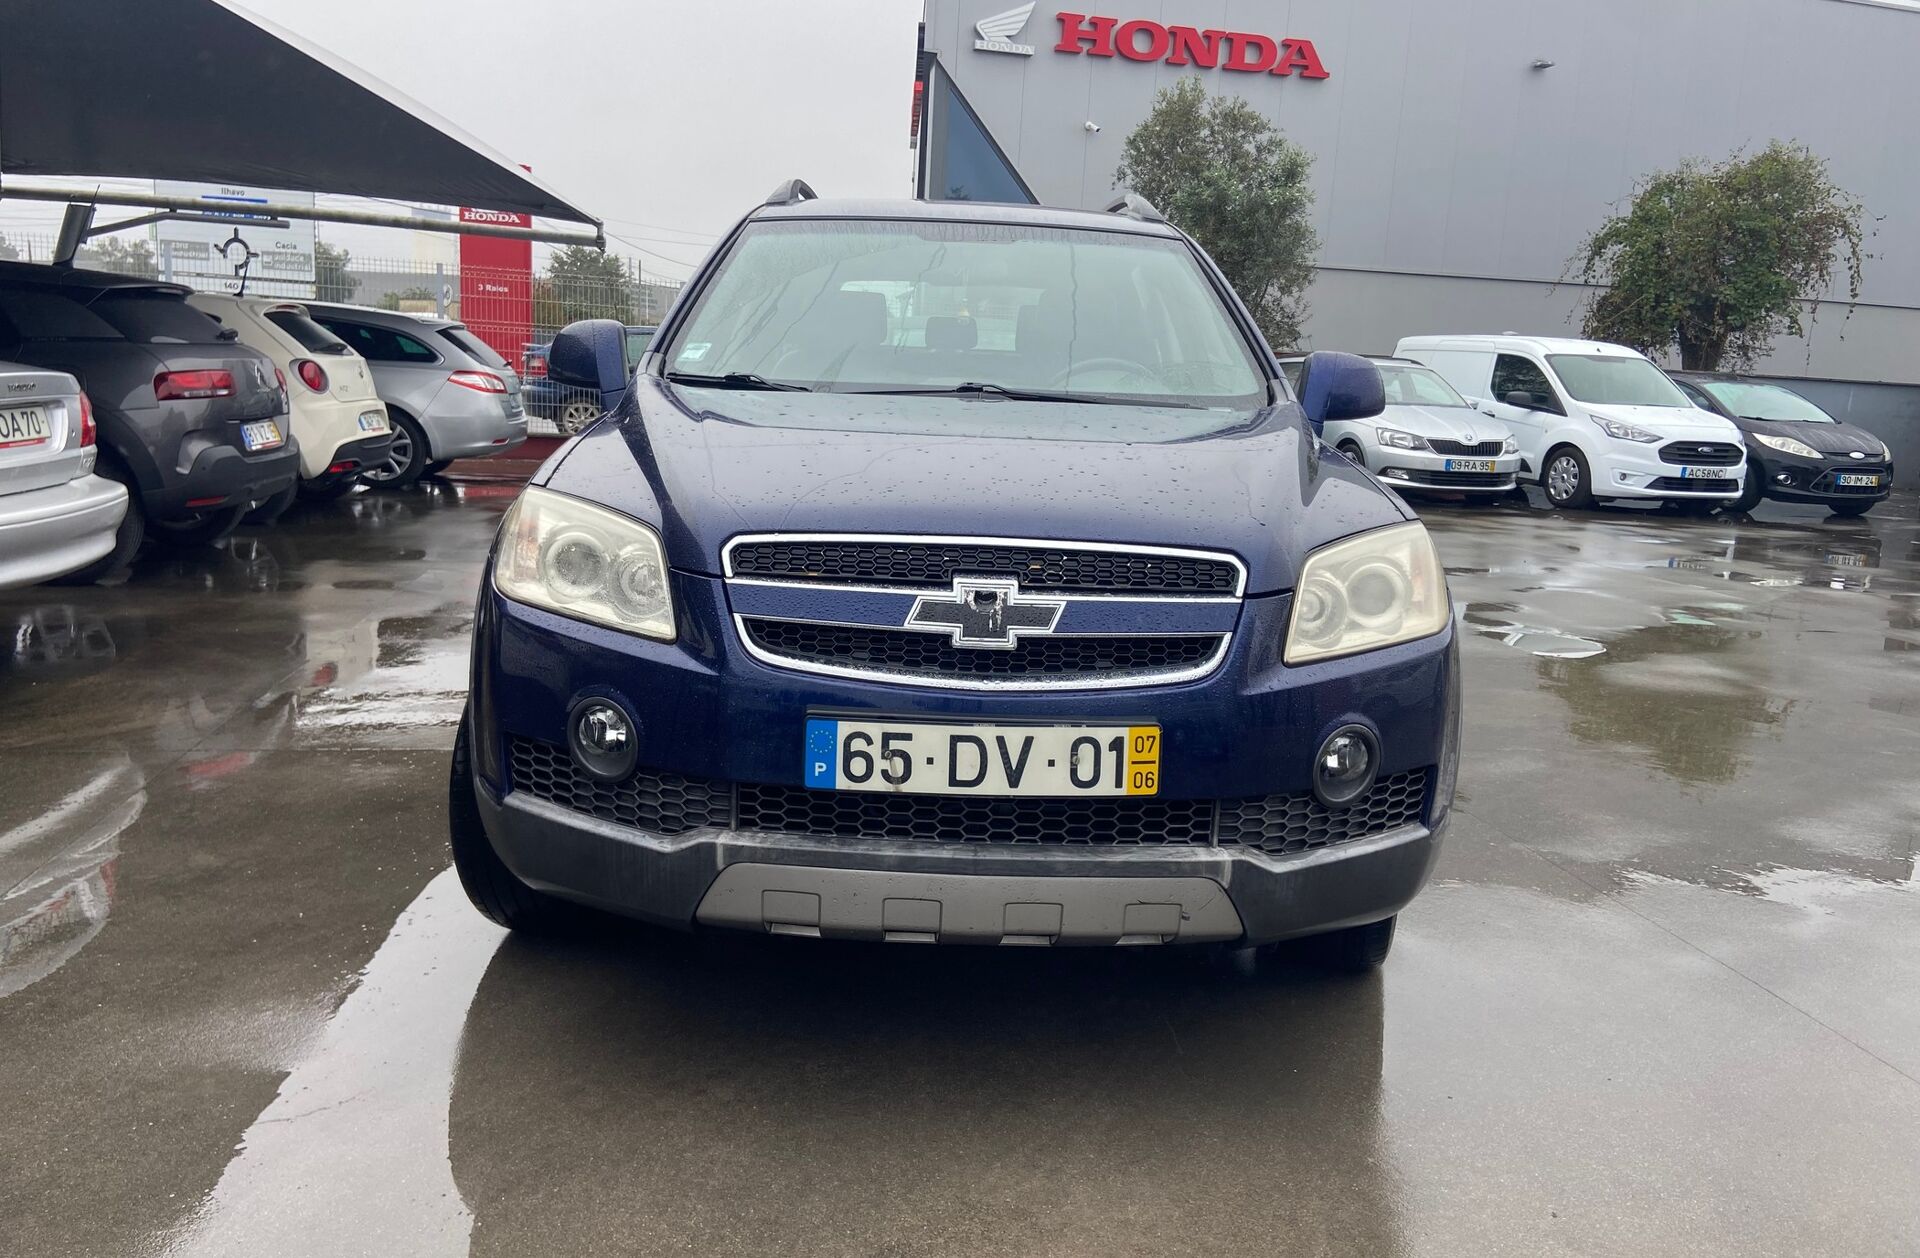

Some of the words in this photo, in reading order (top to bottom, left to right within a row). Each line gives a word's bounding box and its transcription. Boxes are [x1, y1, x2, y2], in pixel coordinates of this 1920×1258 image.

[975, 40, 1034, 55] HONDA
[1055, 12, 1330, 79] HONDA
[463, 211, 521, 223] HONDA
[275, 241, 297, 251] Cacia
[1133, 735, 1157, 754] 07
[814, 762, 827, 777] P
[1133, 771, 1155, 789] 06
